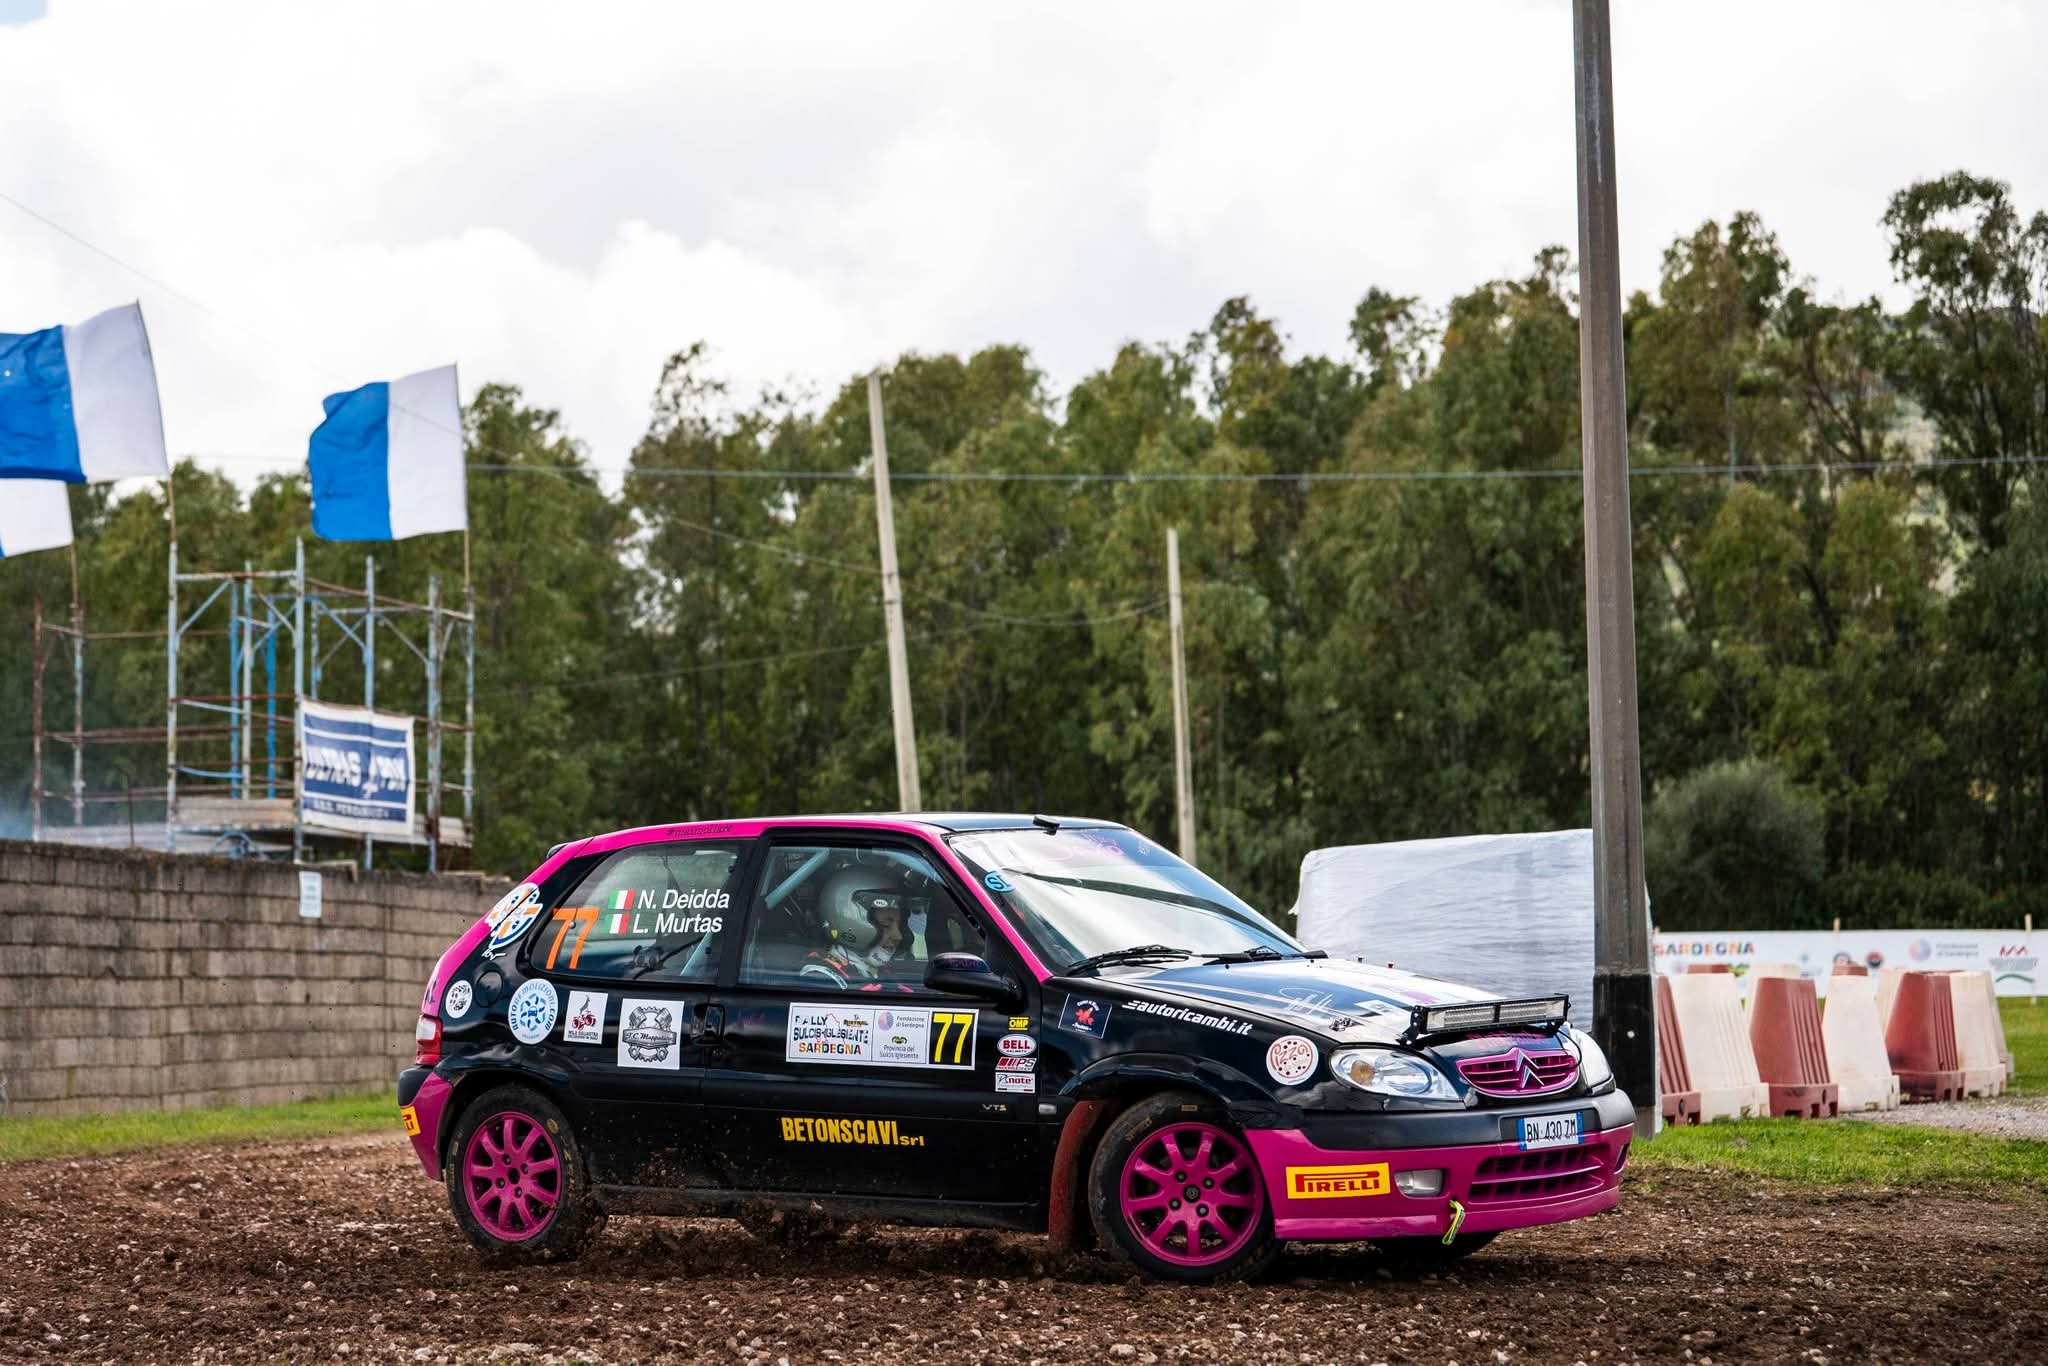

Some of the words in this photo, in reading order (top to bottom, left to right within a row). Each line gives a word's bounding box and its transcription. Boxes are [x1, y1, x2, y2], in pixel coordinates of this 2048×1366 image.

[638, 889, 656, 909] N.
[662, 889, 729, 909] Deidda
[632, 914, 648, 933] L.
[655, 913, 722, 933] Murtas
[546, 907, 600, 970] 77
[1008, 1019, 1029, 1028] OMP
[799, 1042, 862, 1055] SARDEGNA
[932, 1013, 973, 1064] 77
[1003, 1040, 1031, 1049] BELL
[781, 1117, 899, 1145] BETONSCAVI
[900, 1136, 925, 1146] srl
[1526, 1122, 1540, 1143] BN
[1545, 1120, 1562, 1141] 430
[1564, 1119, 1577, 1138] ZM
[1295, 1170, 1381, 1193] PIRELLI
